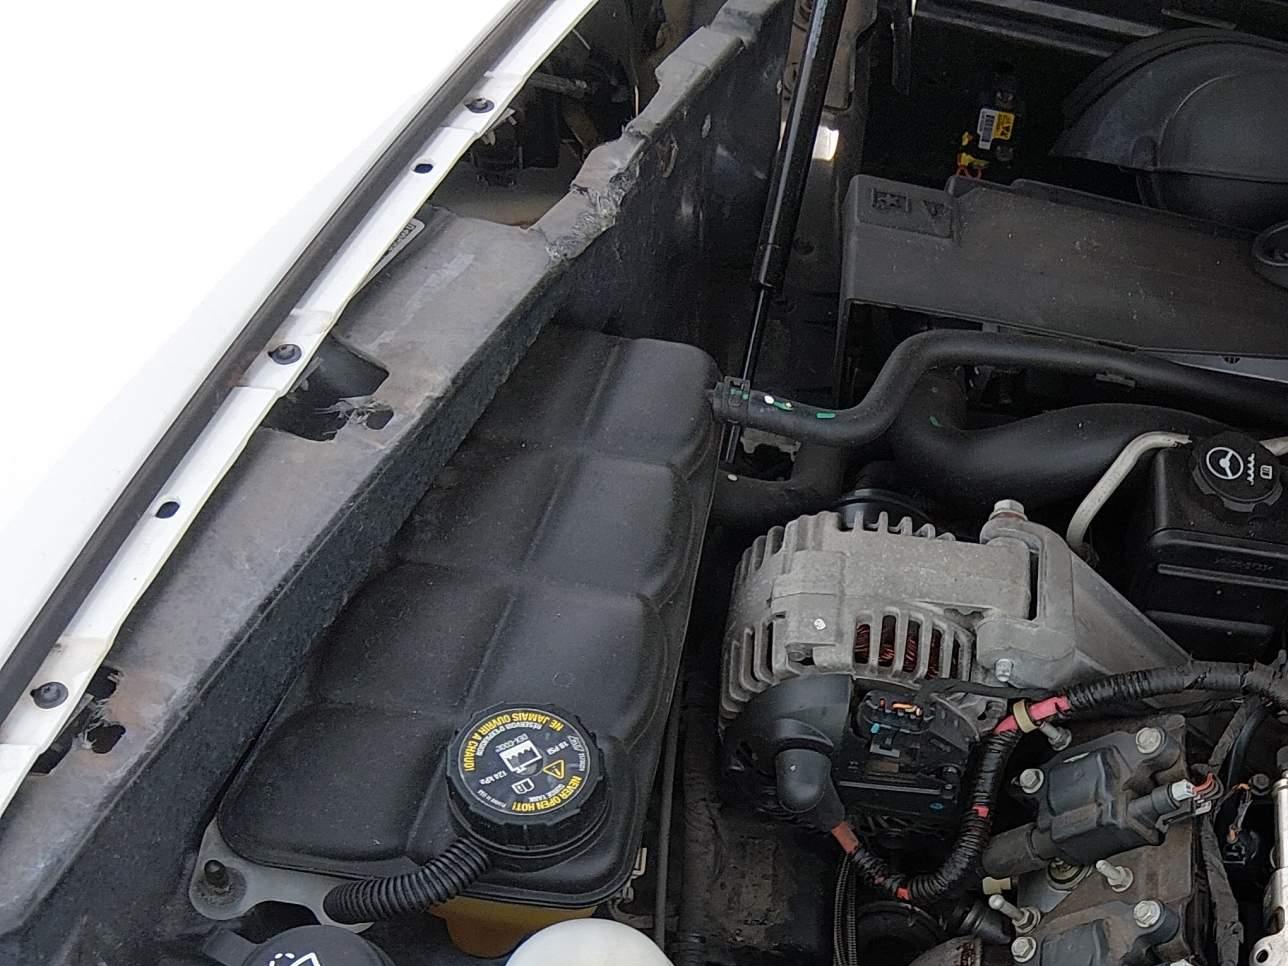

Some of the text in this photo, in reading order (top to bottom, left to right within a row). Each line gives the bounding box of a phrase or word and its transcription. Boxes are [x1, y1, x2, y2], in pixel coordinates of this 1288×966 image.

[479, 716, 511, 735] OUVRIR
[512, 712, 550, 723] JAMAIS
[549, 720, 564, 731] NE
[464, 740, 478, 772] CHAUD!
[512, 775, 582, 812] NEVER OPEN HOT!
